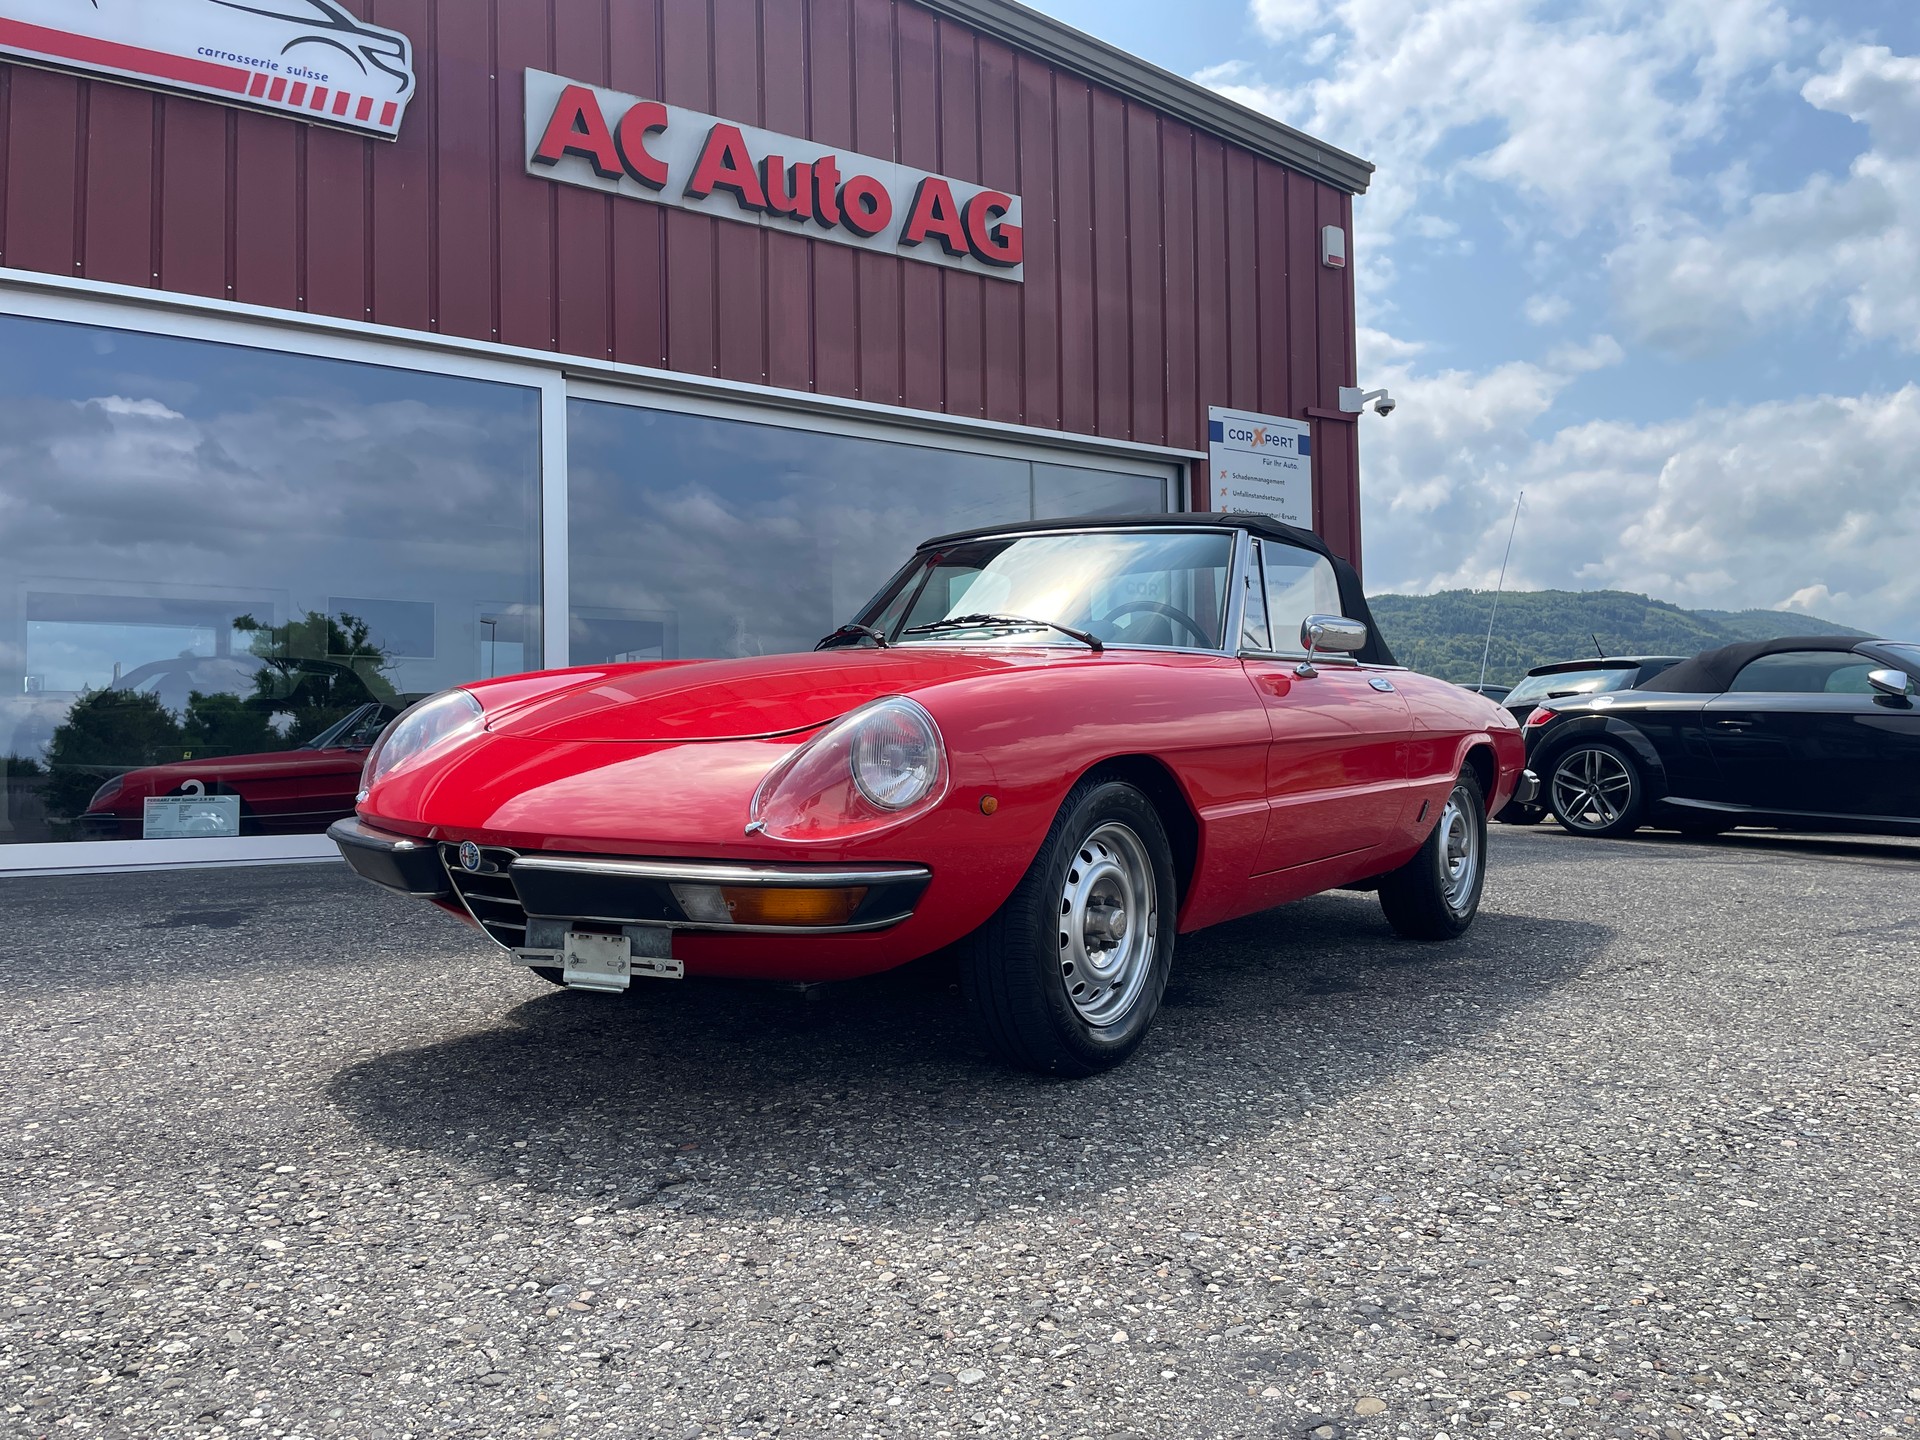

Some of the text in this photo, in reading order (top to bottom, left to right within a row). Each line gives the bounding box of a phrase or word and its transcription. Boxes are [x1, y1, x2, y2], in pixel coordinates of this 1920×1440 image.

[197, 46, 329, 82] carrosserie suisse
[531, 84, 1024, 268] AC Auto AG
[1262, 458, 1272, 466] Für
[1273, 459, 1282, 467] Ihr
[1232, 472, 1285, 486] Schadenmanagement
[1232, 490, 1285, 503] Unfallinstandsetzung
